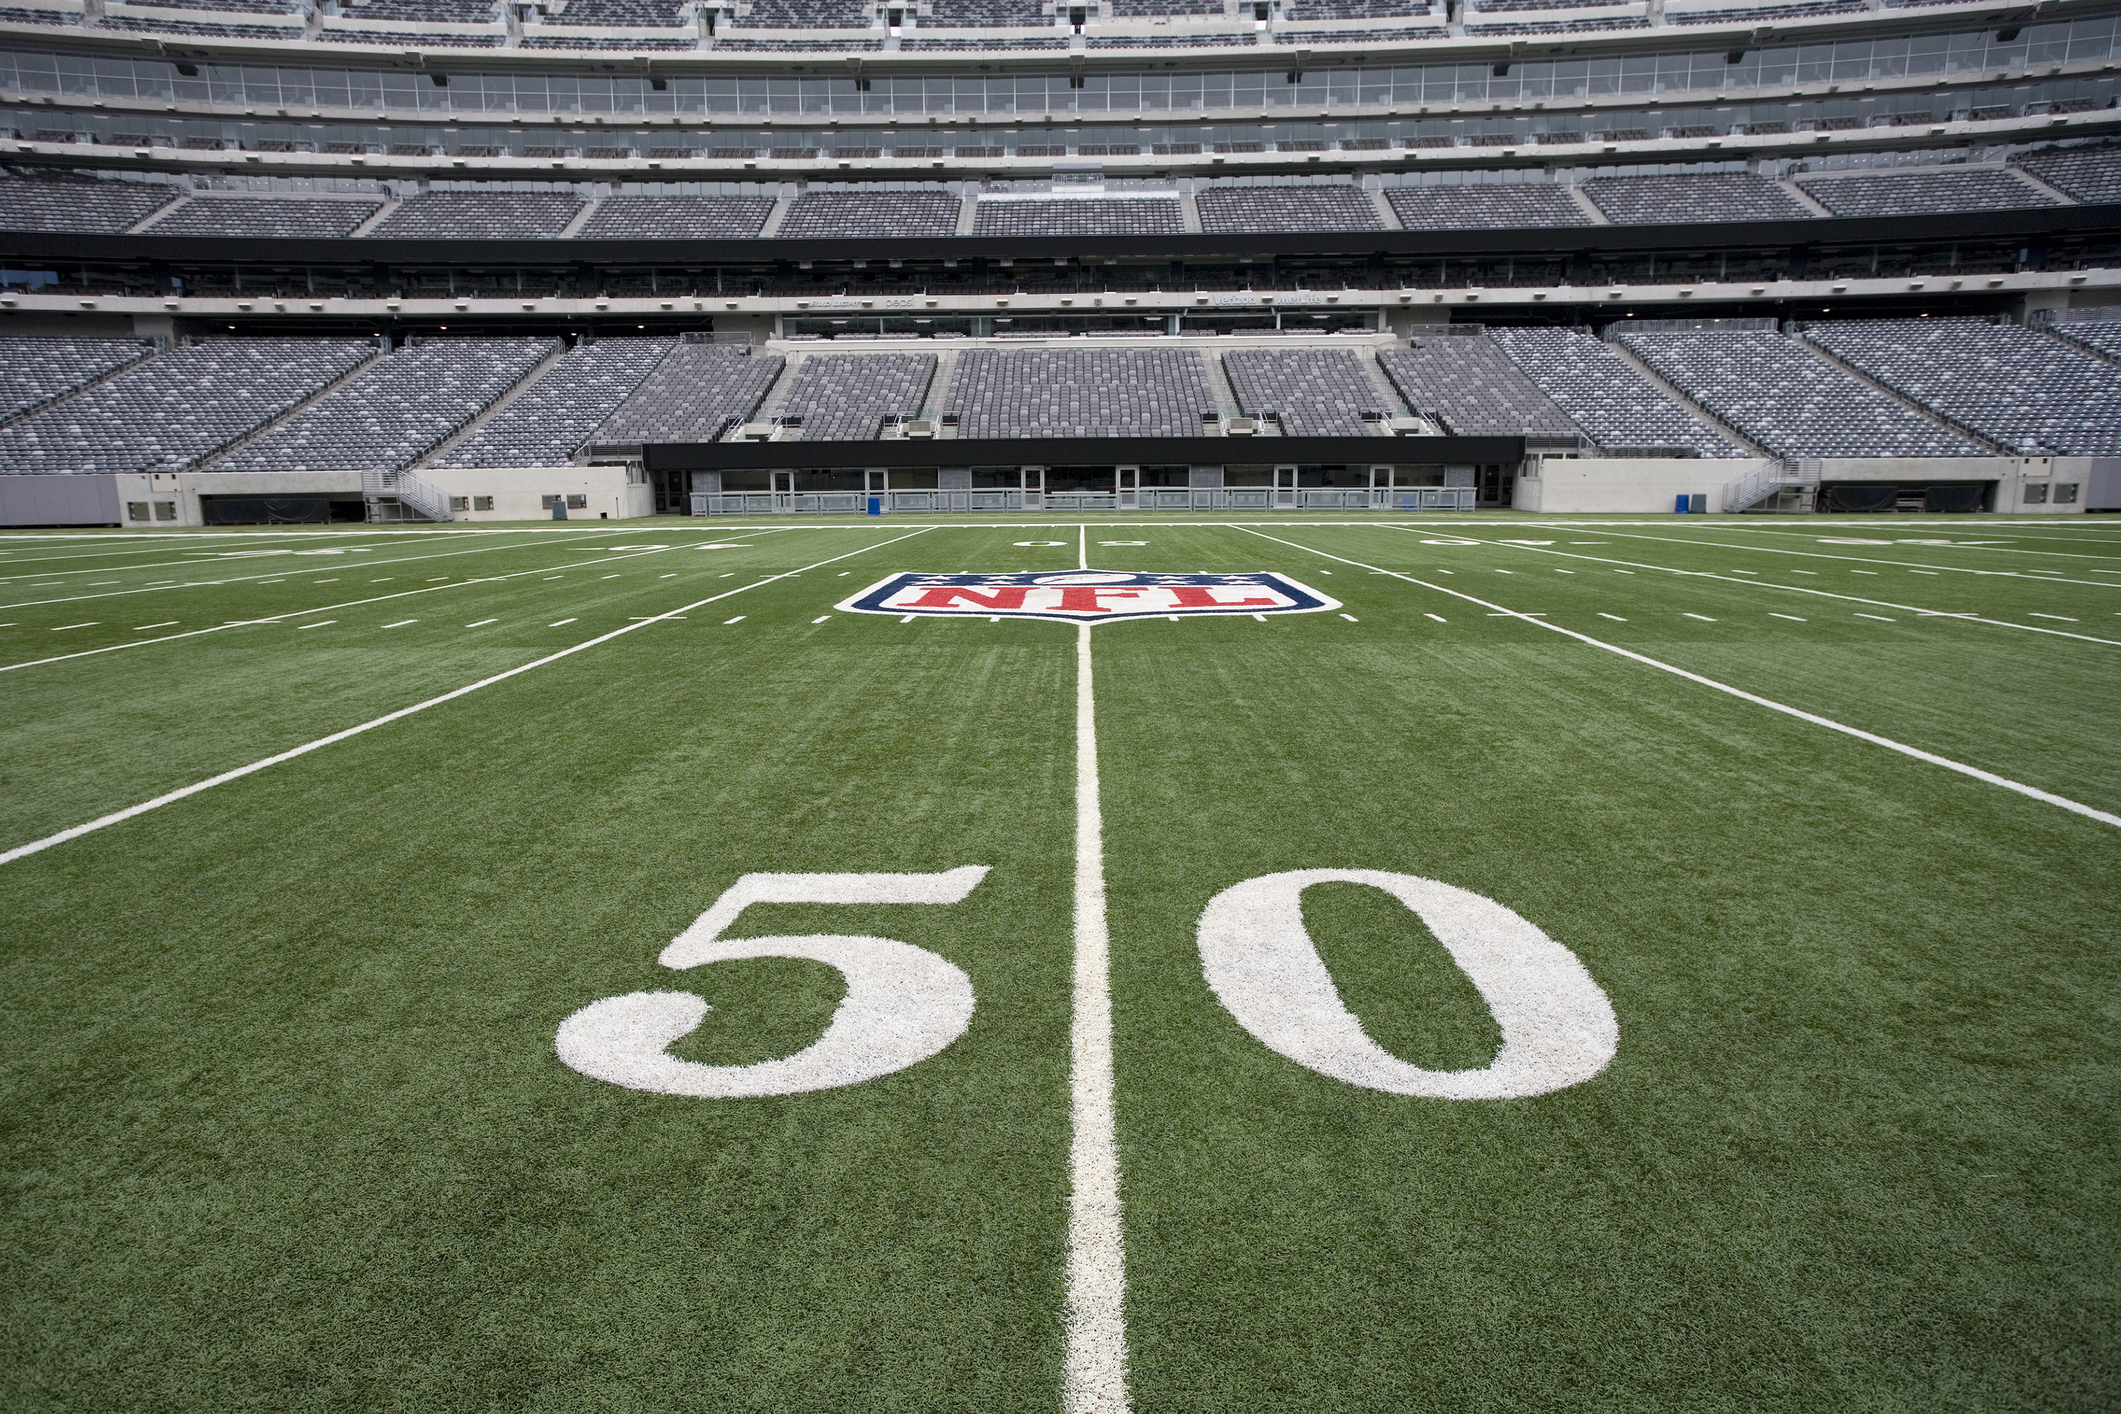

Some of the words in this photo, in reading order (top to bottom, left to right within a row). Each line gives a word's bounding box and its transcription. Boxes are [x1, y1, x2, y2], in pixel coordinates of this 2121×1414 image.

[886, 298, 914, 309] pepsi
[897, 586, 1278, 613] NFL
[555, 865, 1619, 1100] 50
